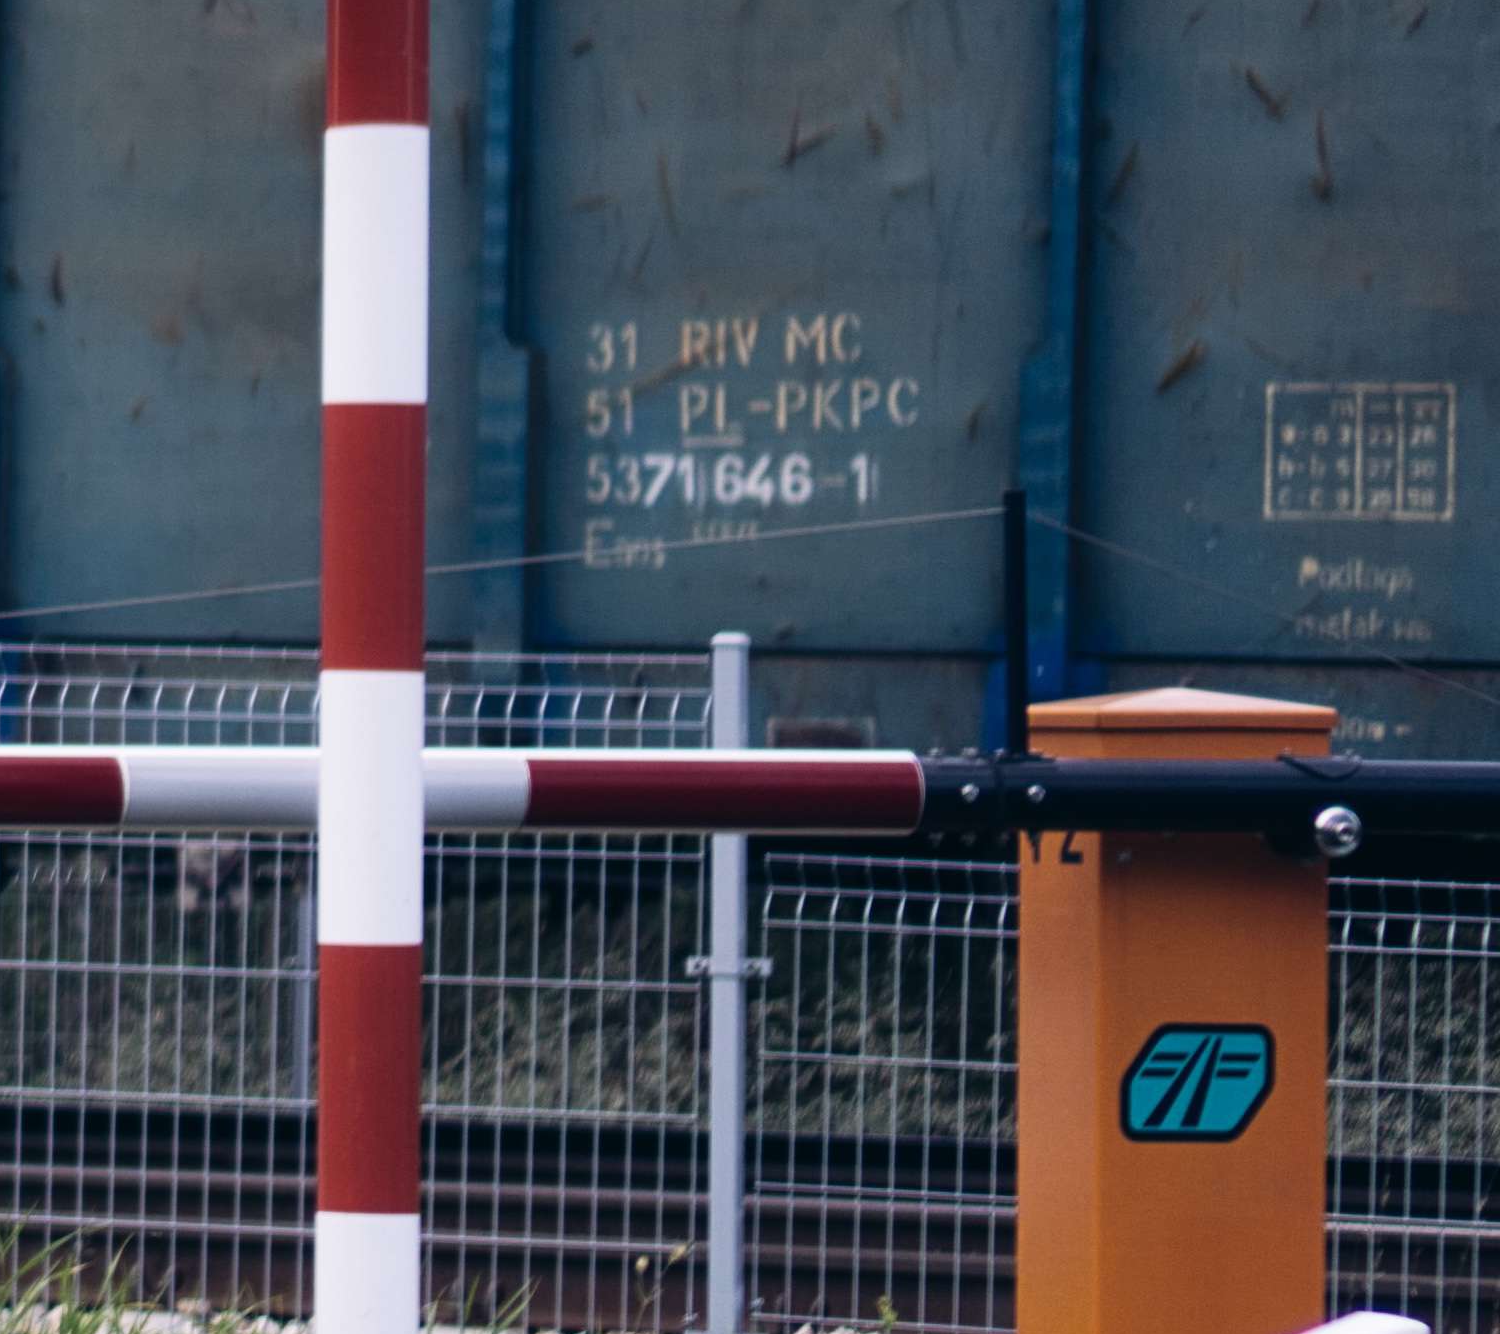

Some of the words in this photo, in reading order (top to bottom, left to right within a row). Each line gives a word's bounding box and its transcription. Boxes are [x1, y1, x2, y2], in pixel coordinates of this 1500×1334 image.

[588, 322, 637, 372] 31
[680, 317, 760, 367] RIV
[784, 312, 862, 365] MC
[586, 387, 634, 437] 51
